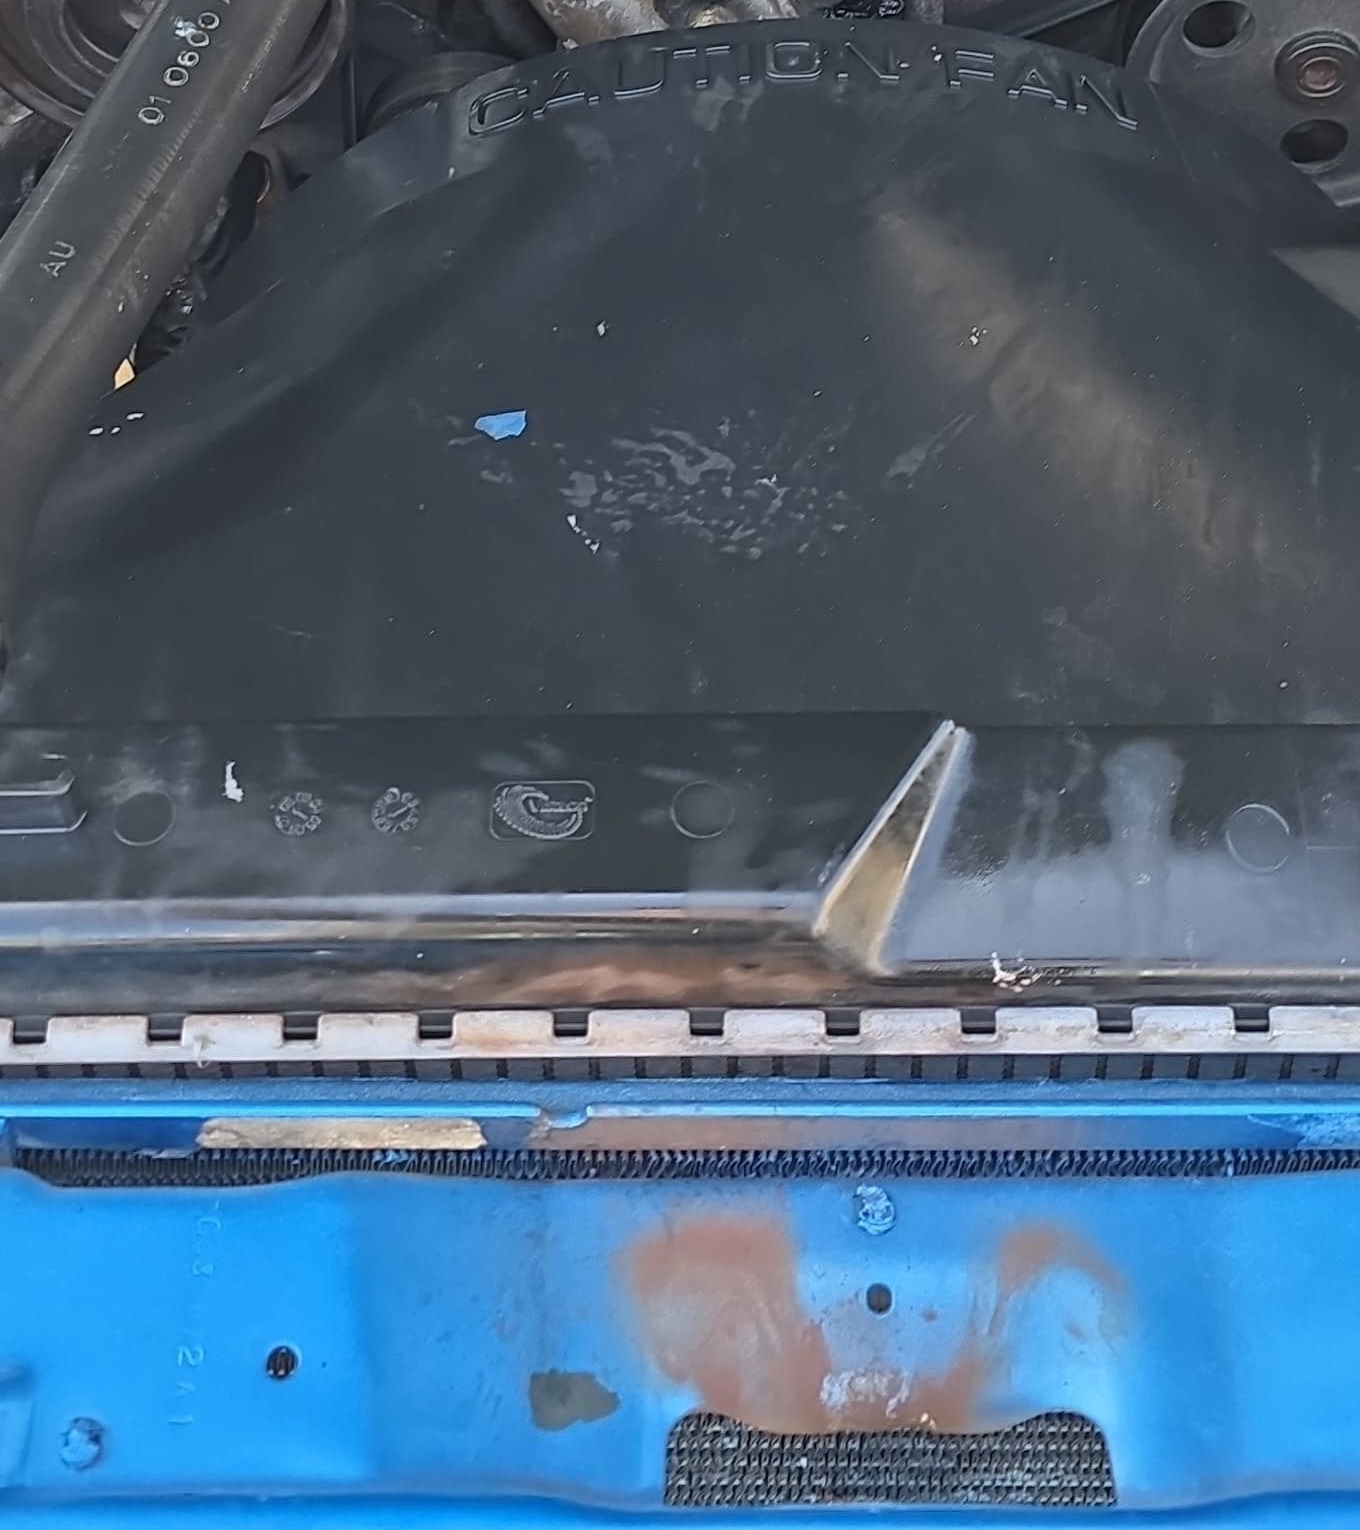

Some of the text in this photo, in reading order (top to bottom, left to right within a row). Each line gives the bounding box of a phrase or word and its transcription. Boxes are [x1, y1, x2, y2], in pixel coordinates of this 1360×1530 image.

[137, 93, 172, 126] 01
[163, 12, 221, 87] 0600
[466, 39, 1140, 138] CAUTION FAN
[41, 241, 77, 277] AU
